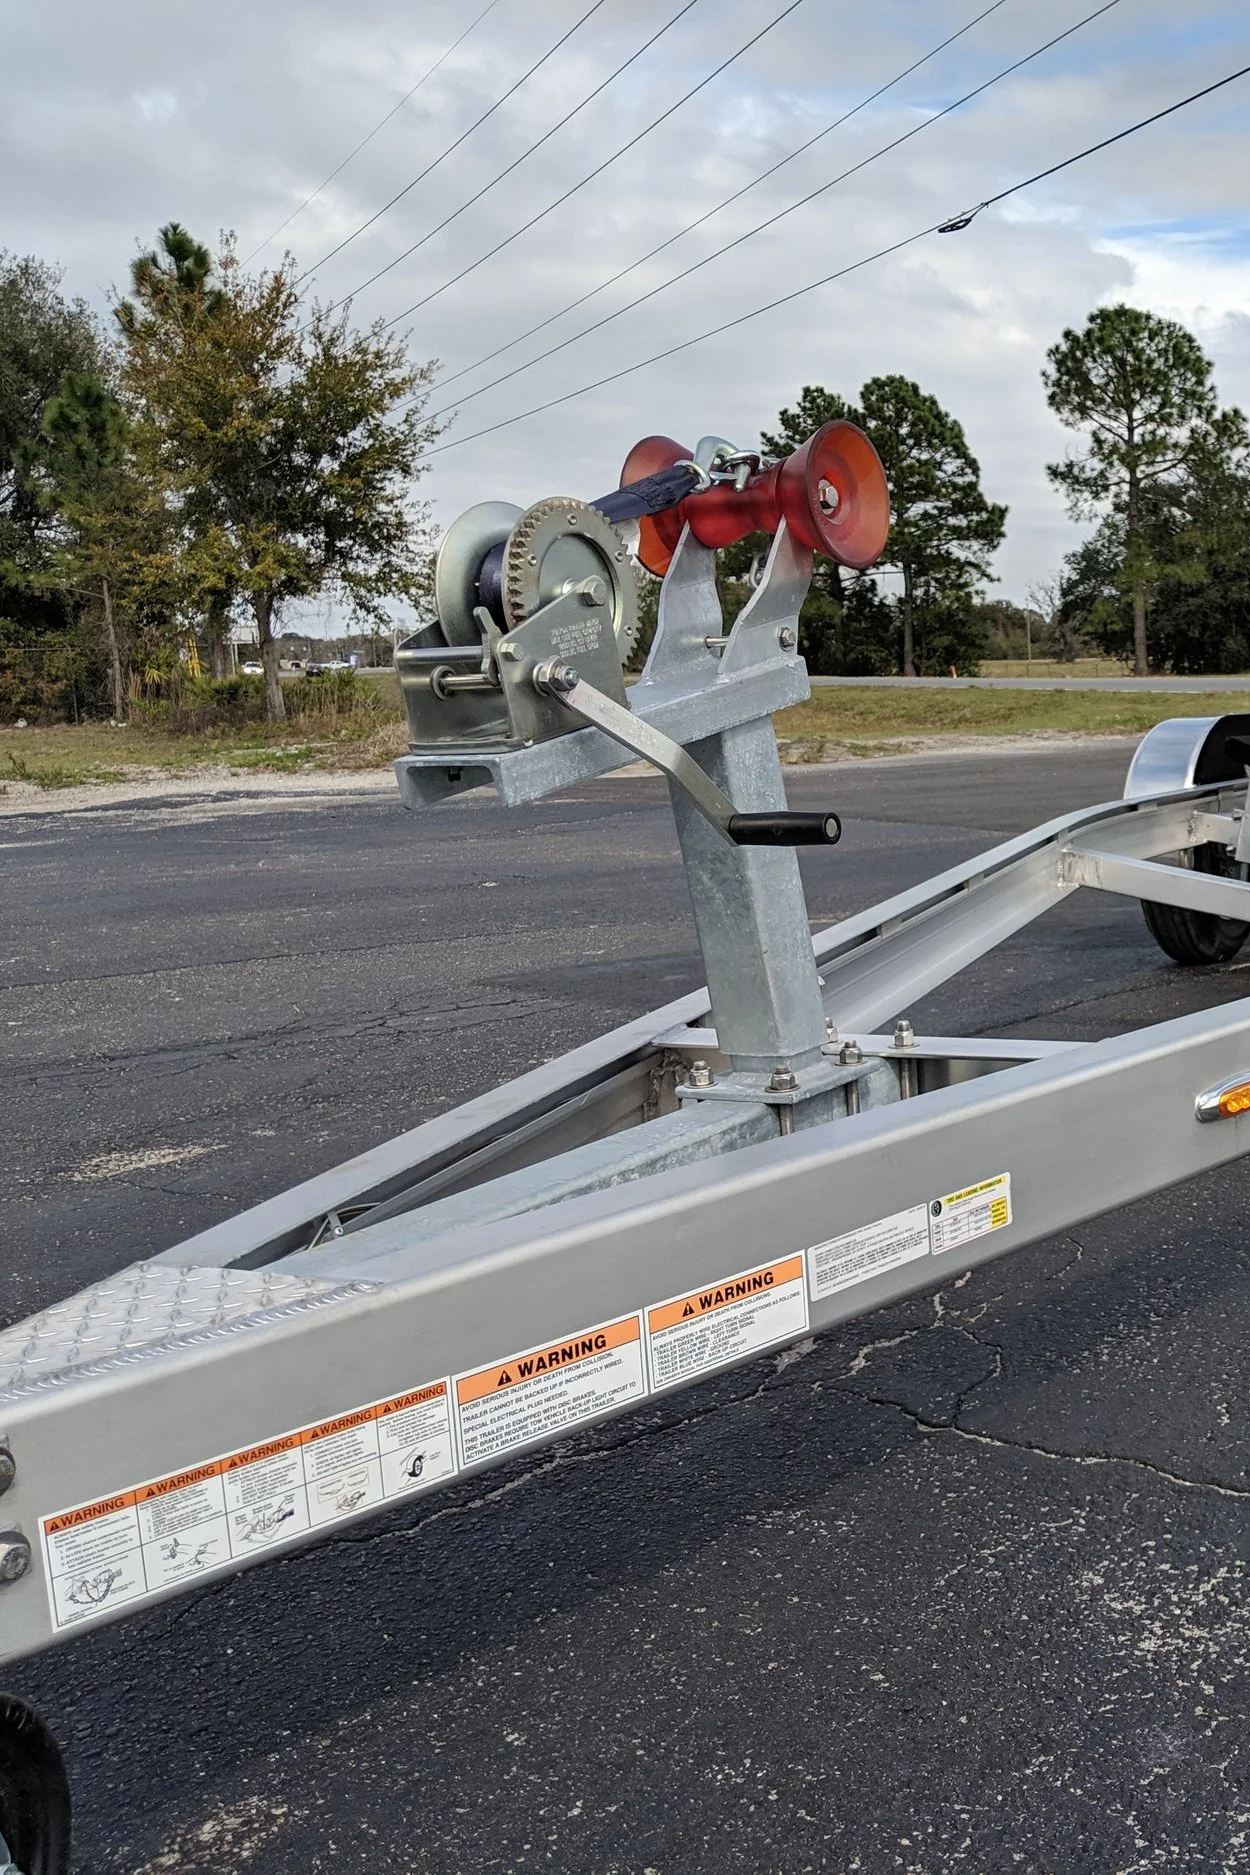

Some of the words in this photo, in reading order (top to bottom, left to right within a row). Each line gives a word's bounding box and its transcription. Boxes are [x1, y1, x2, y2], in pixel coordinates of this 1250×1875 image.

[699, 1272, 774, 1310] WARNING
[519, 1334, 607, 1378] WARNING
[394, 1386, 443, 1409] WARNING
[462, 1401, 480, 1413] AVOID
[482, 1390, 509, 1405] SERIOUS
[511, 1382, 531, 1394] INJURY
[533, 1378, 542, 1386] OR
[544, 1370, 563, 1382] DEATH
[565, 1364, 581, 1374] FROM
[463, 1409, 488, 1424] TRAILER
[489, 1399, 514, 1414] CANNOT
[515, 1396, 523, 1404] BE
[525, 1386, 548, 1400] BACKED
[550, 1383, 557, 1391] UP
[565, 1366, 603, 1385] INCORRECTLY
[320, 1411, 371, 1436] WARNING
[464, 1420, 489, 1435] SPECIAL
[490, 1406, 526, 1424] ELECTRICAL
[528, 1400, 543, 1410] PLUG
[465, 1436, 478, 1446] THIS
[480, 1425, 504, 1440] TRAILER
[513, 1411, 541, 1427] EQUIPPED
[543, 1405, 557, 1415] WITH
[558, 1399, 571, 1409] DISC
[466, 1443, 478, 1453] DISC
[480, 1433, 503, 1447] BRAKES
[505, 1423, 529, 1438] REQUIRE
[531, 1417, 544, 1427] TOW
[544, 1409, 566, 1422] VEHICLE
[592, 1392, 607, 1403] LIGHT
[608, 1384, 628, 1396] CIRCUIT
[466, 1445, 494, 1461] ACTIVATE
[501, 1434, 521, 1447] BRAKE
[522, 1423, 548, 1438] RELEASE
[550, 1416, 567, 1427] VALVE
[579, 1406, 590, 1415] THIS
[239, 1439, 294, 1464] WARNING
[157, 1467, 215, 1493] WARNING
[61, 1498, 124, 1527] WARNING
